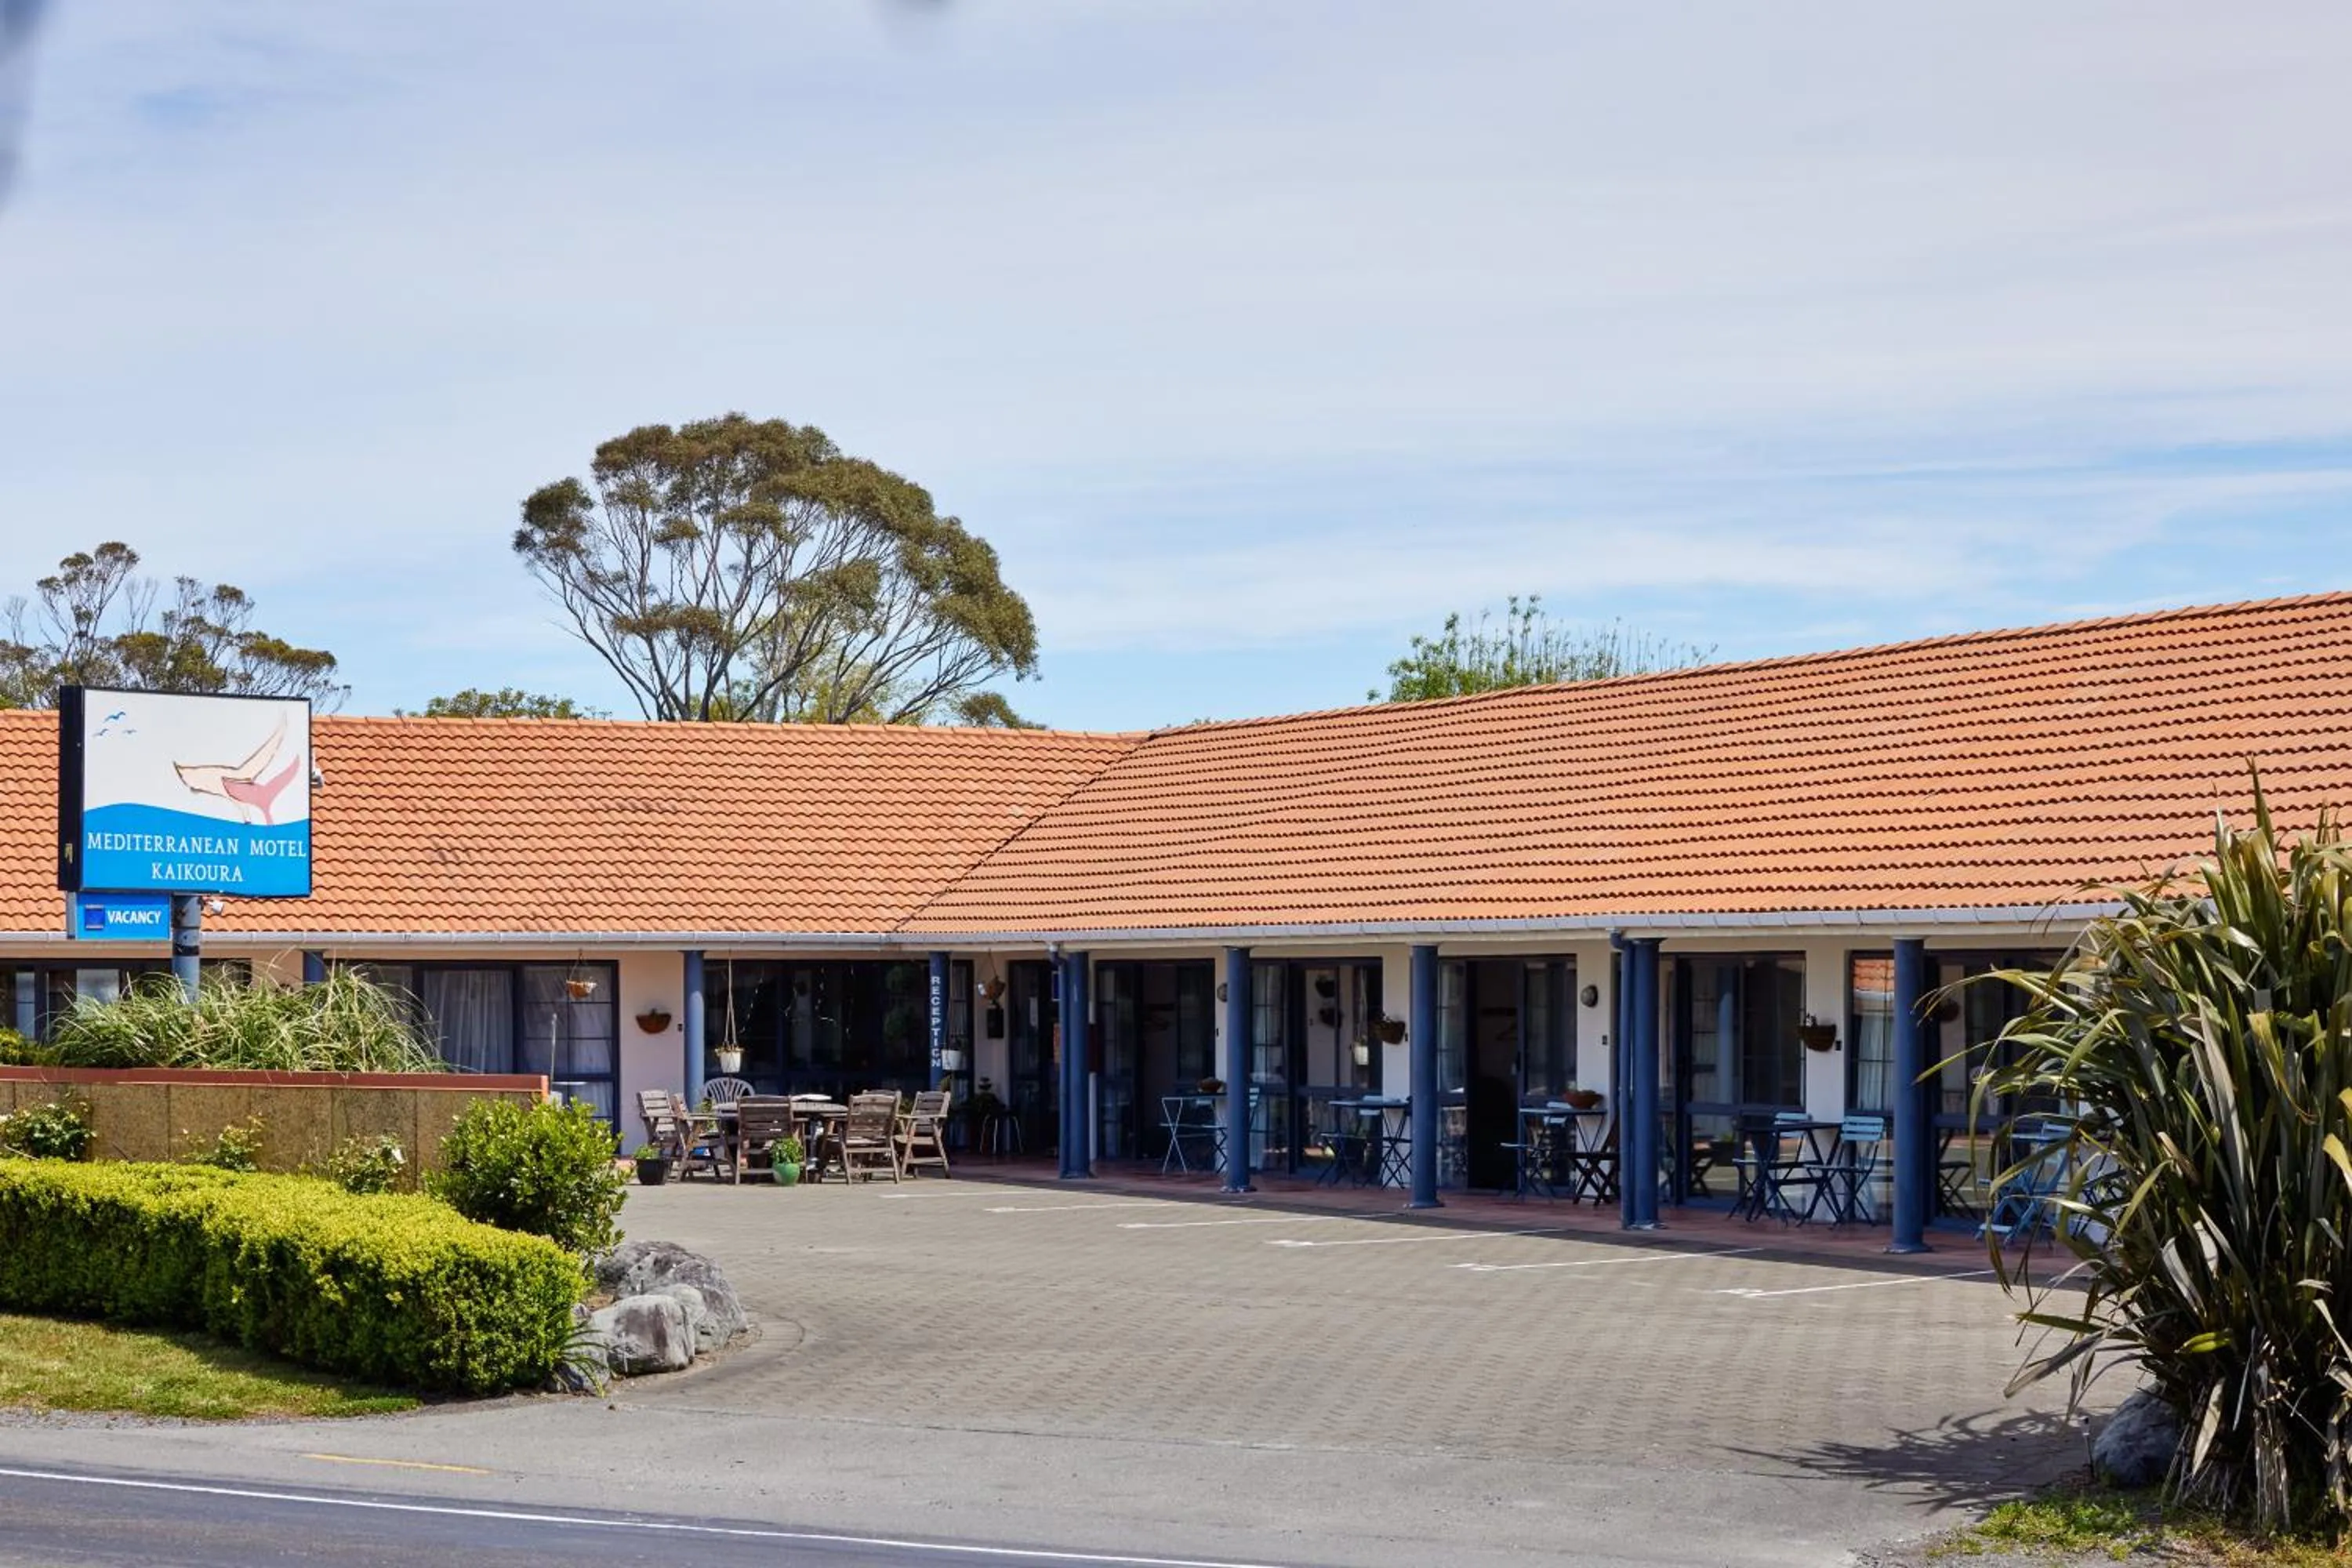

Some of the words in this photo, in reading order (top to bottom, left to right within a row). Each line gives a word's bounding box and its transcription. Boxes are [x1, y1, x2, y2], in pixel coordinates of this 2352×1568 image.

[87, 832, 238, 855] MEDITERRANEAN
[249, 840, 307, 857] MOTEL
[151, 862, 243, 882] KAIKOURA
[107, 910, 162, 924] VACANCY
[931, 976, 941, 1067] RECEPTION
